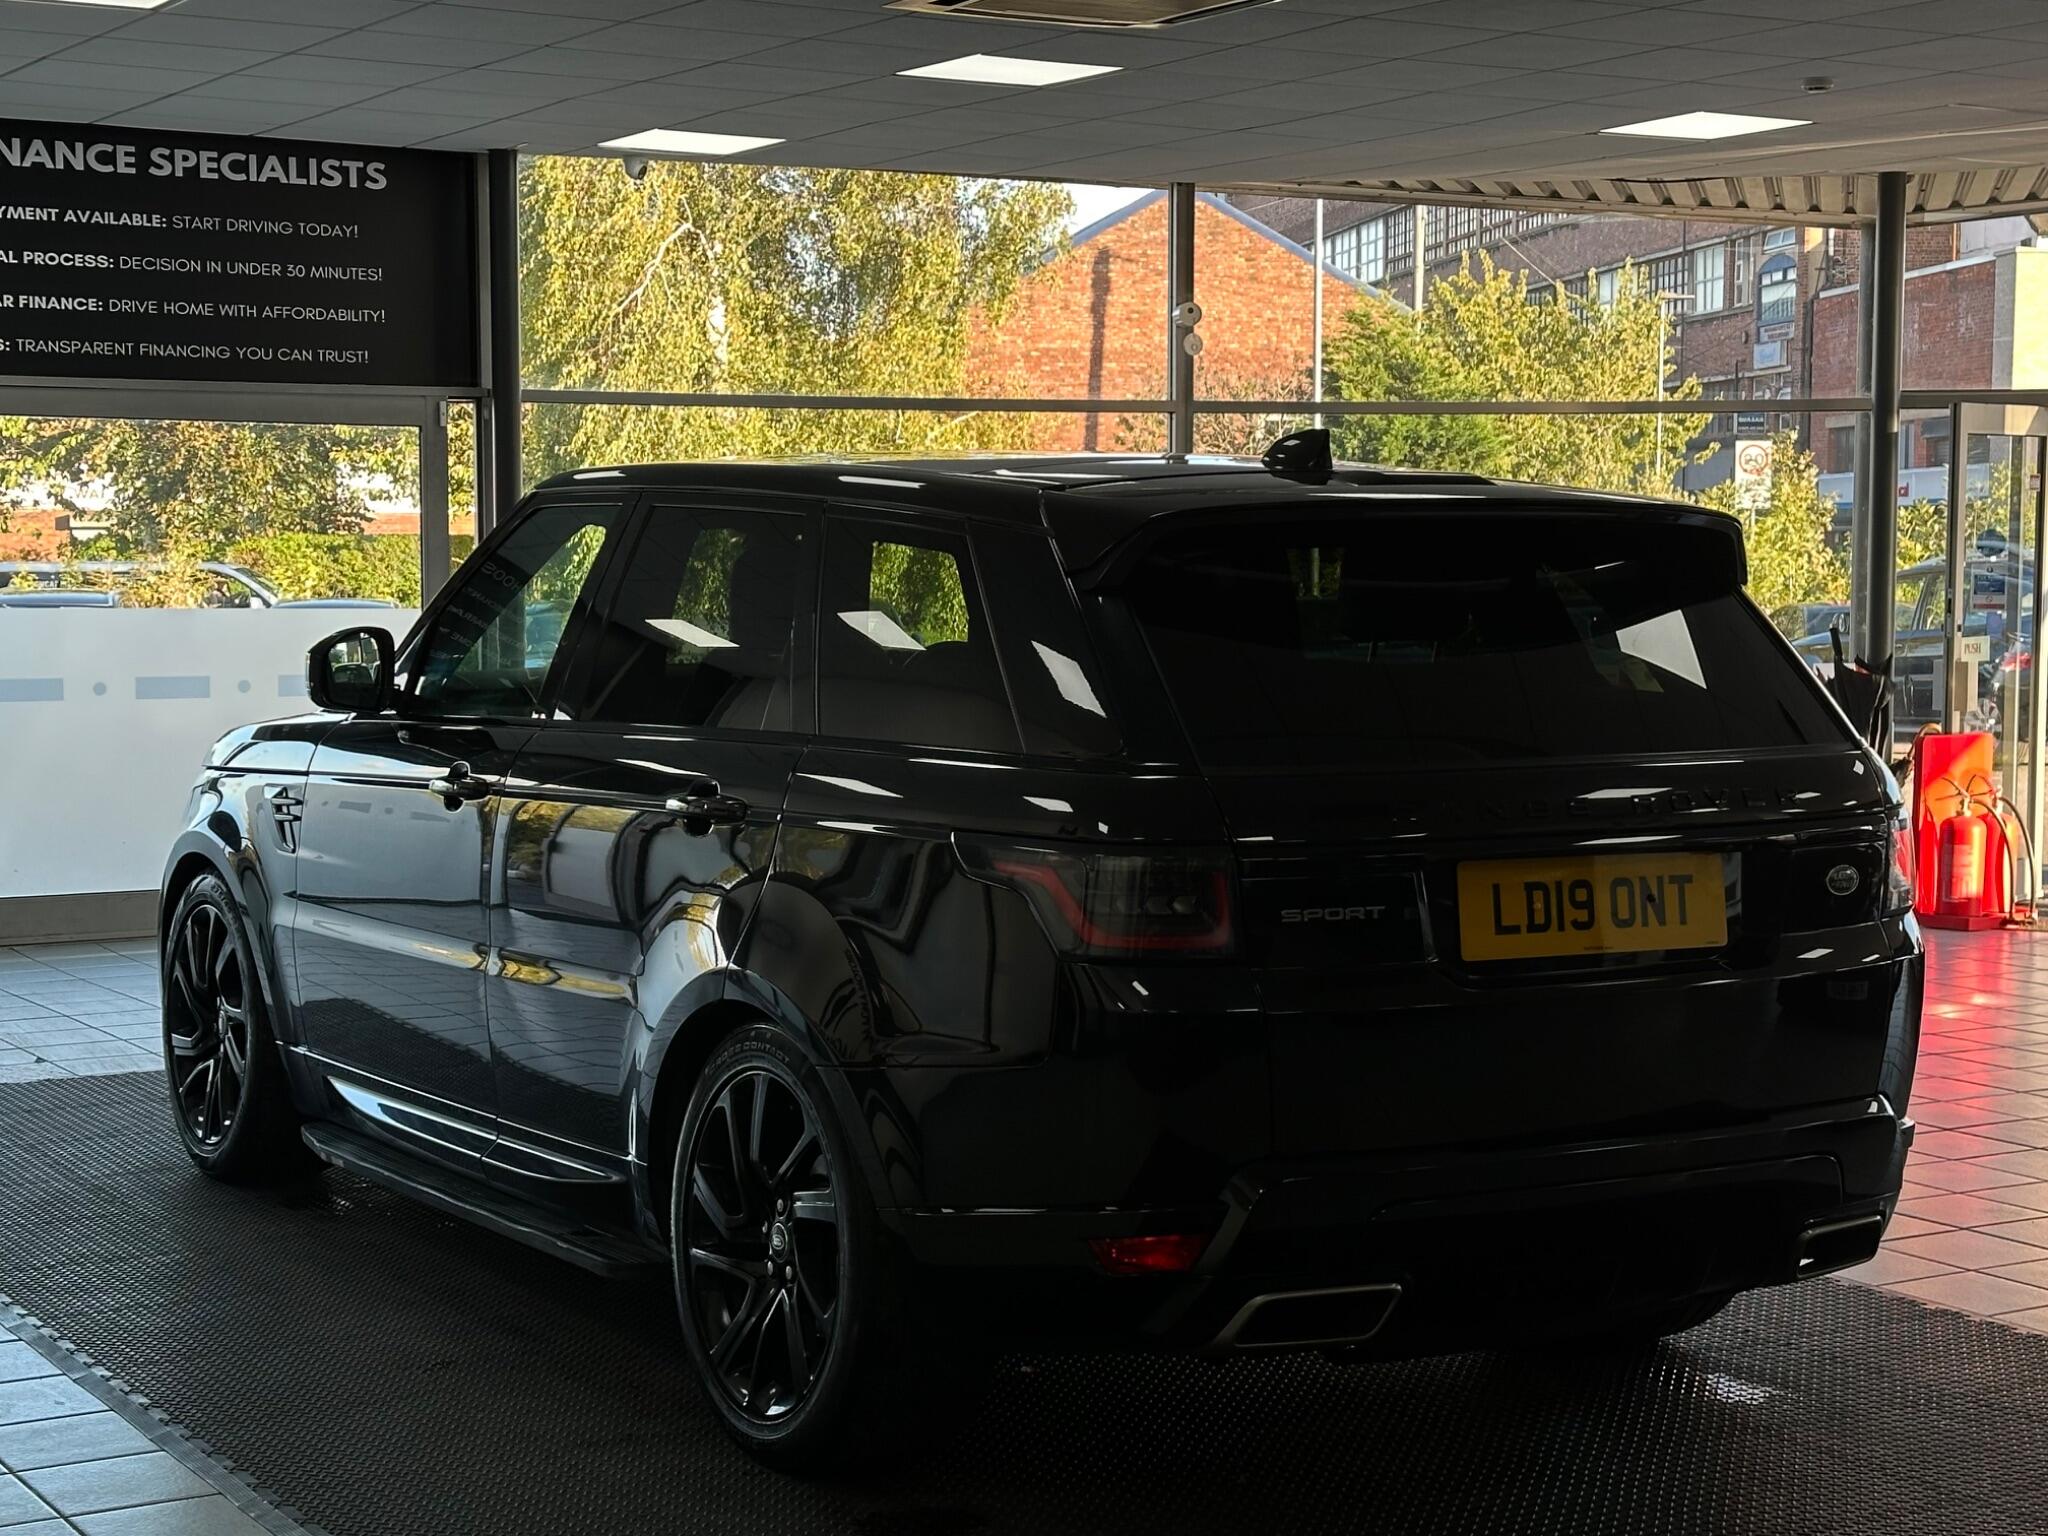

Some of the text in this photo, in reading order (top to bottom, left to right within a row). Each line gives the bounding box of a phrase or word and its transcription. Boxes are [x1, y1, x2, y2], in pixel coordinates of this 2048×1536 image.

[0, 137, 388, 190] NANCE SPECIALISTS
[63, 209, 167, 228] AVAILABLE:
[172, 215, 222, 231] START
[226, 218, 293, 235] DRIVING
[298, 222, 359, 238] TODAY!
[23, 251, 114, 268] PROCESS:
[119, 256, 201, 273] DECISION
[206, 261, 221, 273] IN
[227, 262, 281, 276] UNDER
[286, 264, 305, 277] 30
[310, 265, 383, 281] MINUTES!
[19, 295, 103, 311] FINANCE:
[109, 299, 158, 314] DRIVE
[163, 302, 214, 317] HOME
[219, 304, 257, 318] WITH
[261, 305, 386, 323] AFFORDABILITY!
[16, 338, 135, 356] TRANSPARENT
[139, 343, 231, 359] FINANCING
[235, 347, 274, 361] YOU
[277, 348, 313, 362] CAN
[317, 350, 369, 364] TRUST!
[1964, 643, 1982, 655] PUSH
[1631, 785, 1803, 814] ROVER
[1280, 905, 1387, 923] SPORT
[1491, 874, 1694, 935] LD19 ONT
